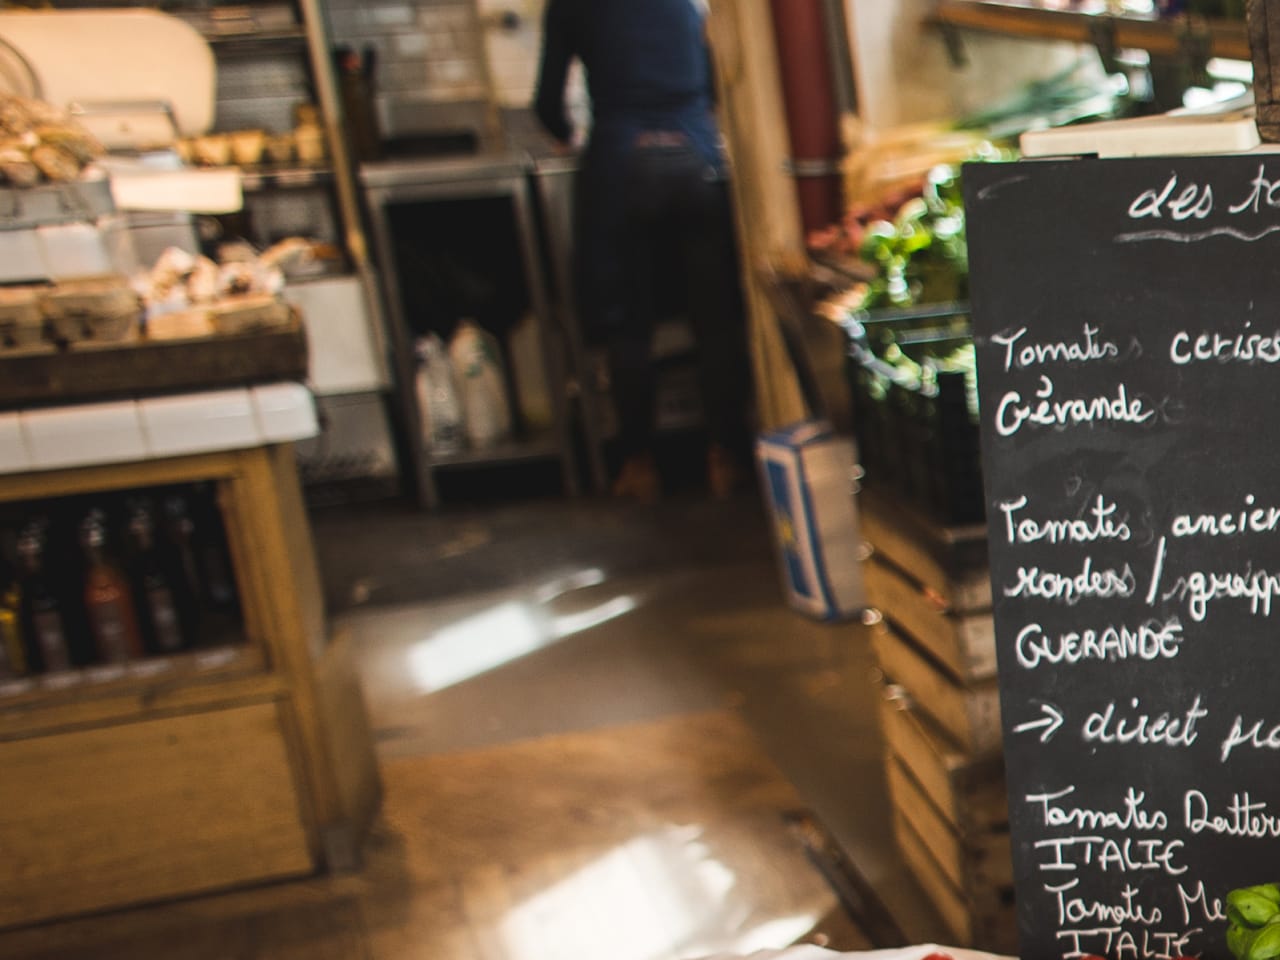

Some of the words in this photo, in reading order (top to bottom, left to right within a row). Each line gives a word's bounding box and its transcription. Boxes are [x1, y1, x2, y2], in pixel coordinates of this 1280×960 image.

[1000, 494, 1131, 545] Tomates
[1081, 696, 1208, 746] direct
[1025, 785, 1168, 831] Tomates
[1034, 836, 1188, 875] ITALIE
[1044, 878, 1162, 925] Tomates
[1056, 926, 1203, 960] ITALIE
